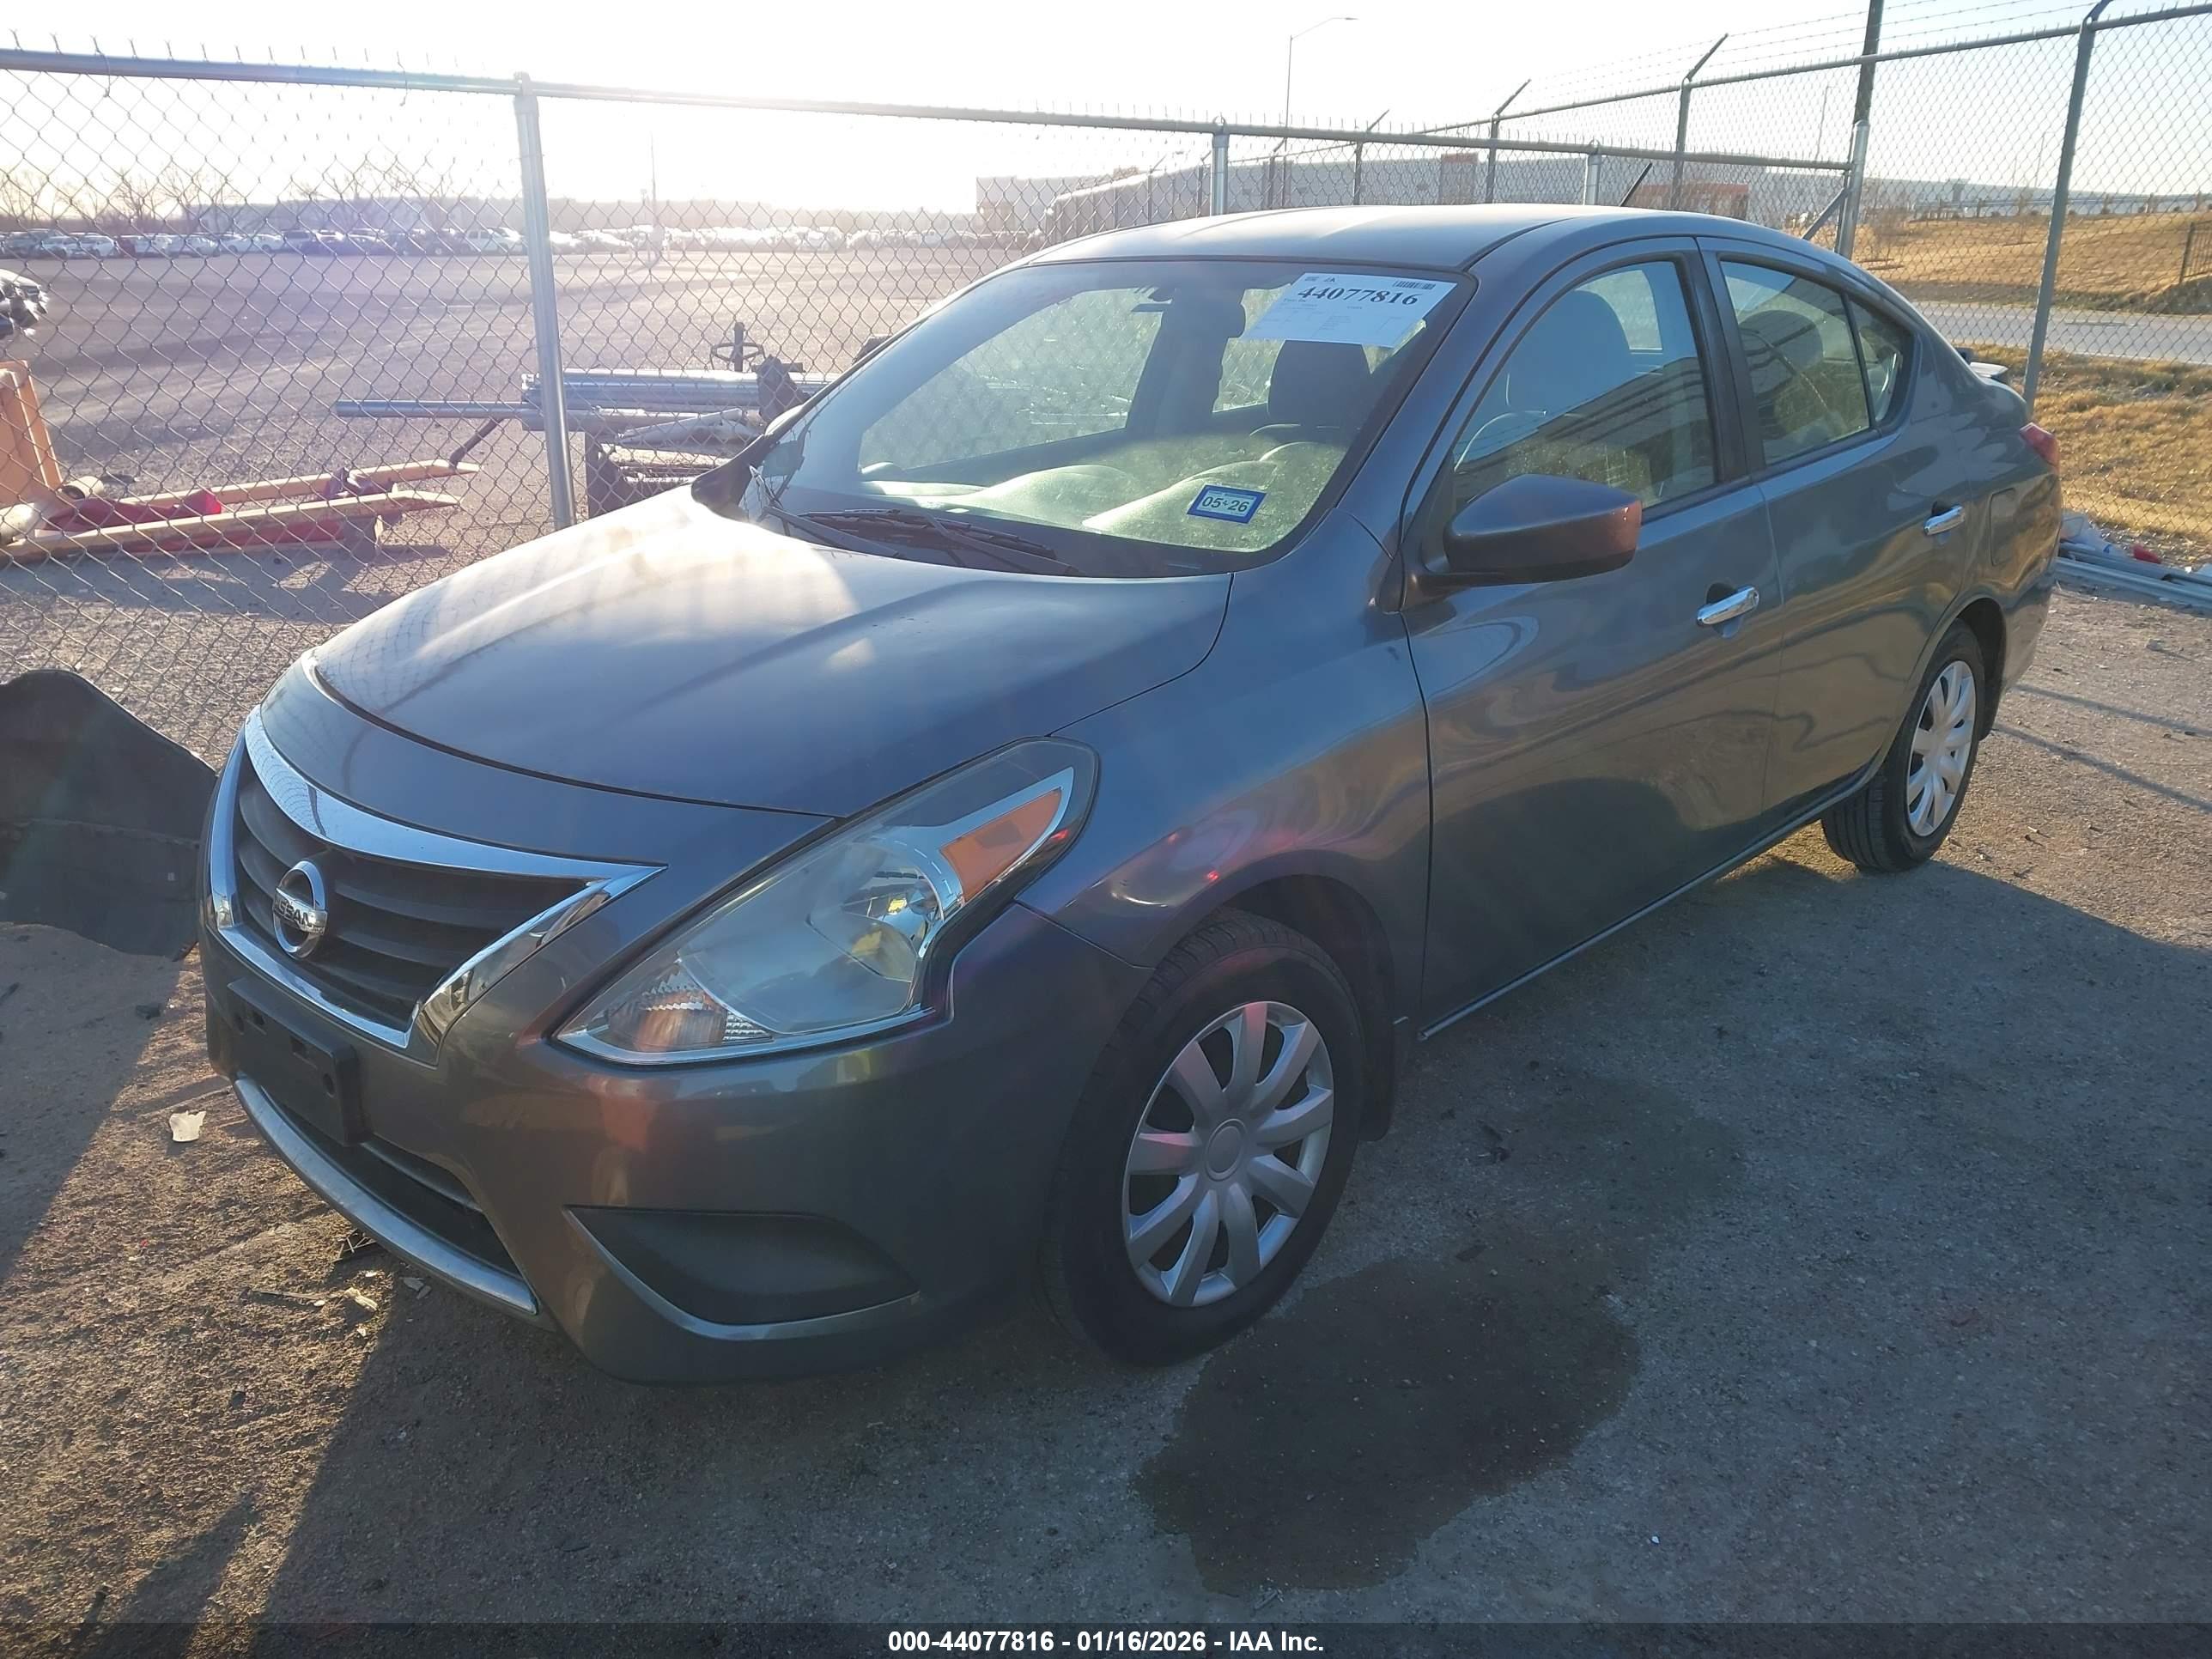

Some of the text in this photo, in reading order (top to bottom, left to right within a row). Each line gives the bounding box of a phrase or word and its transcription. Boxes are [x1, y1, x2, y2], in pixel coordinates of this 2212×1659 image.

[1297, 286, 1422, 306] 44077816
[1202, 496, 1250, 513] 05 26
